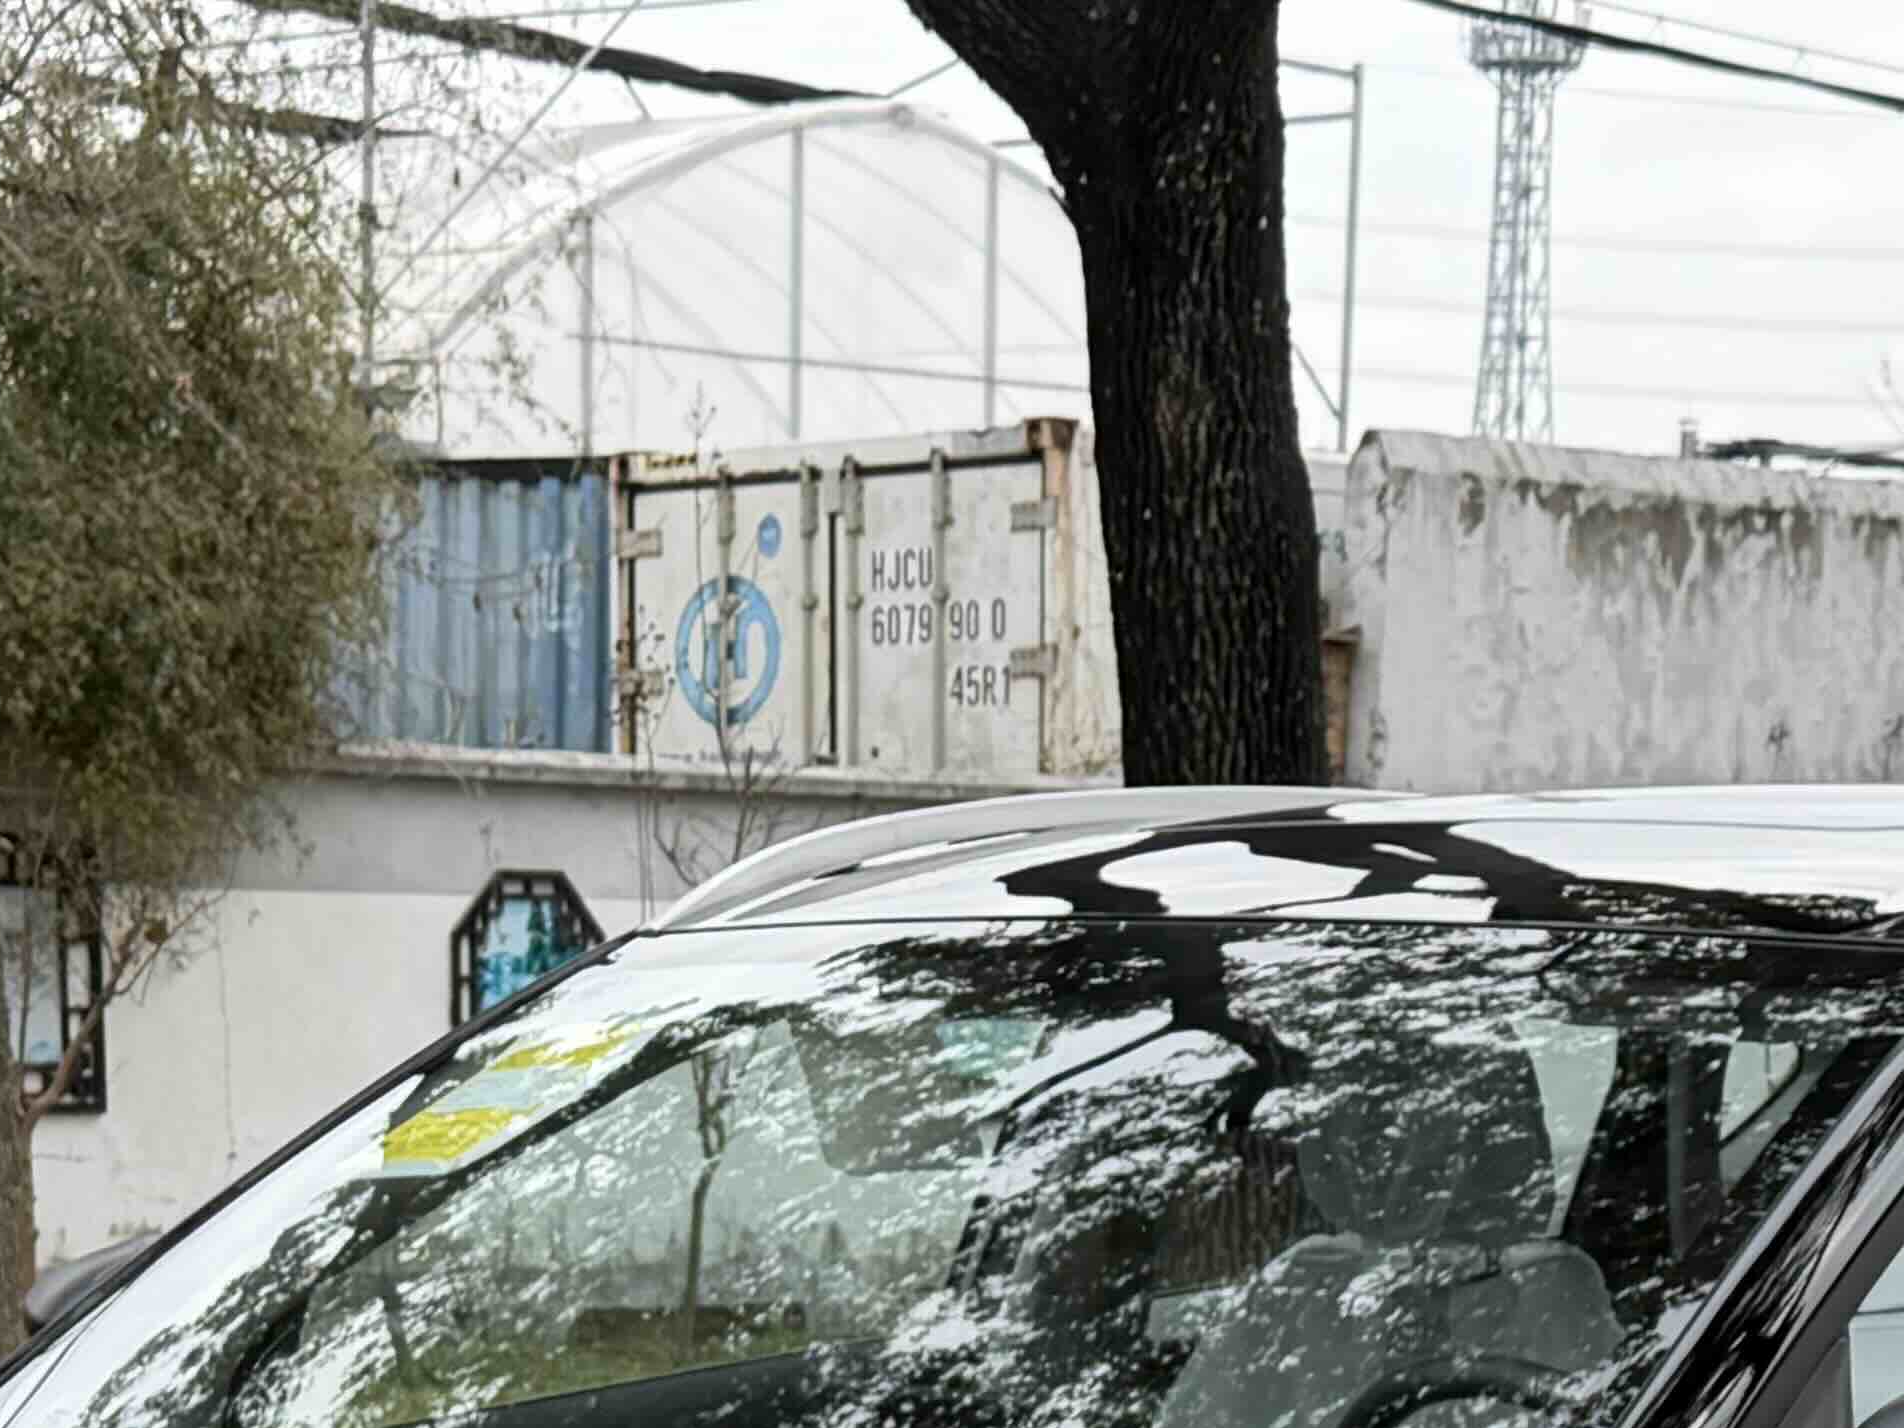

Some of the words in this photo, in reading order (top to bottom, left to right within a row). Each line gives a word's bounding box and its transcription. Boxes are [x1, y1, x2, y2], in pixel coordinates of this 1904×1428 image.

[872, 546, 933, 592] HJCU
[991, 597, 1006, 641] 0
[950, 664, 1011, 706] 45R1
